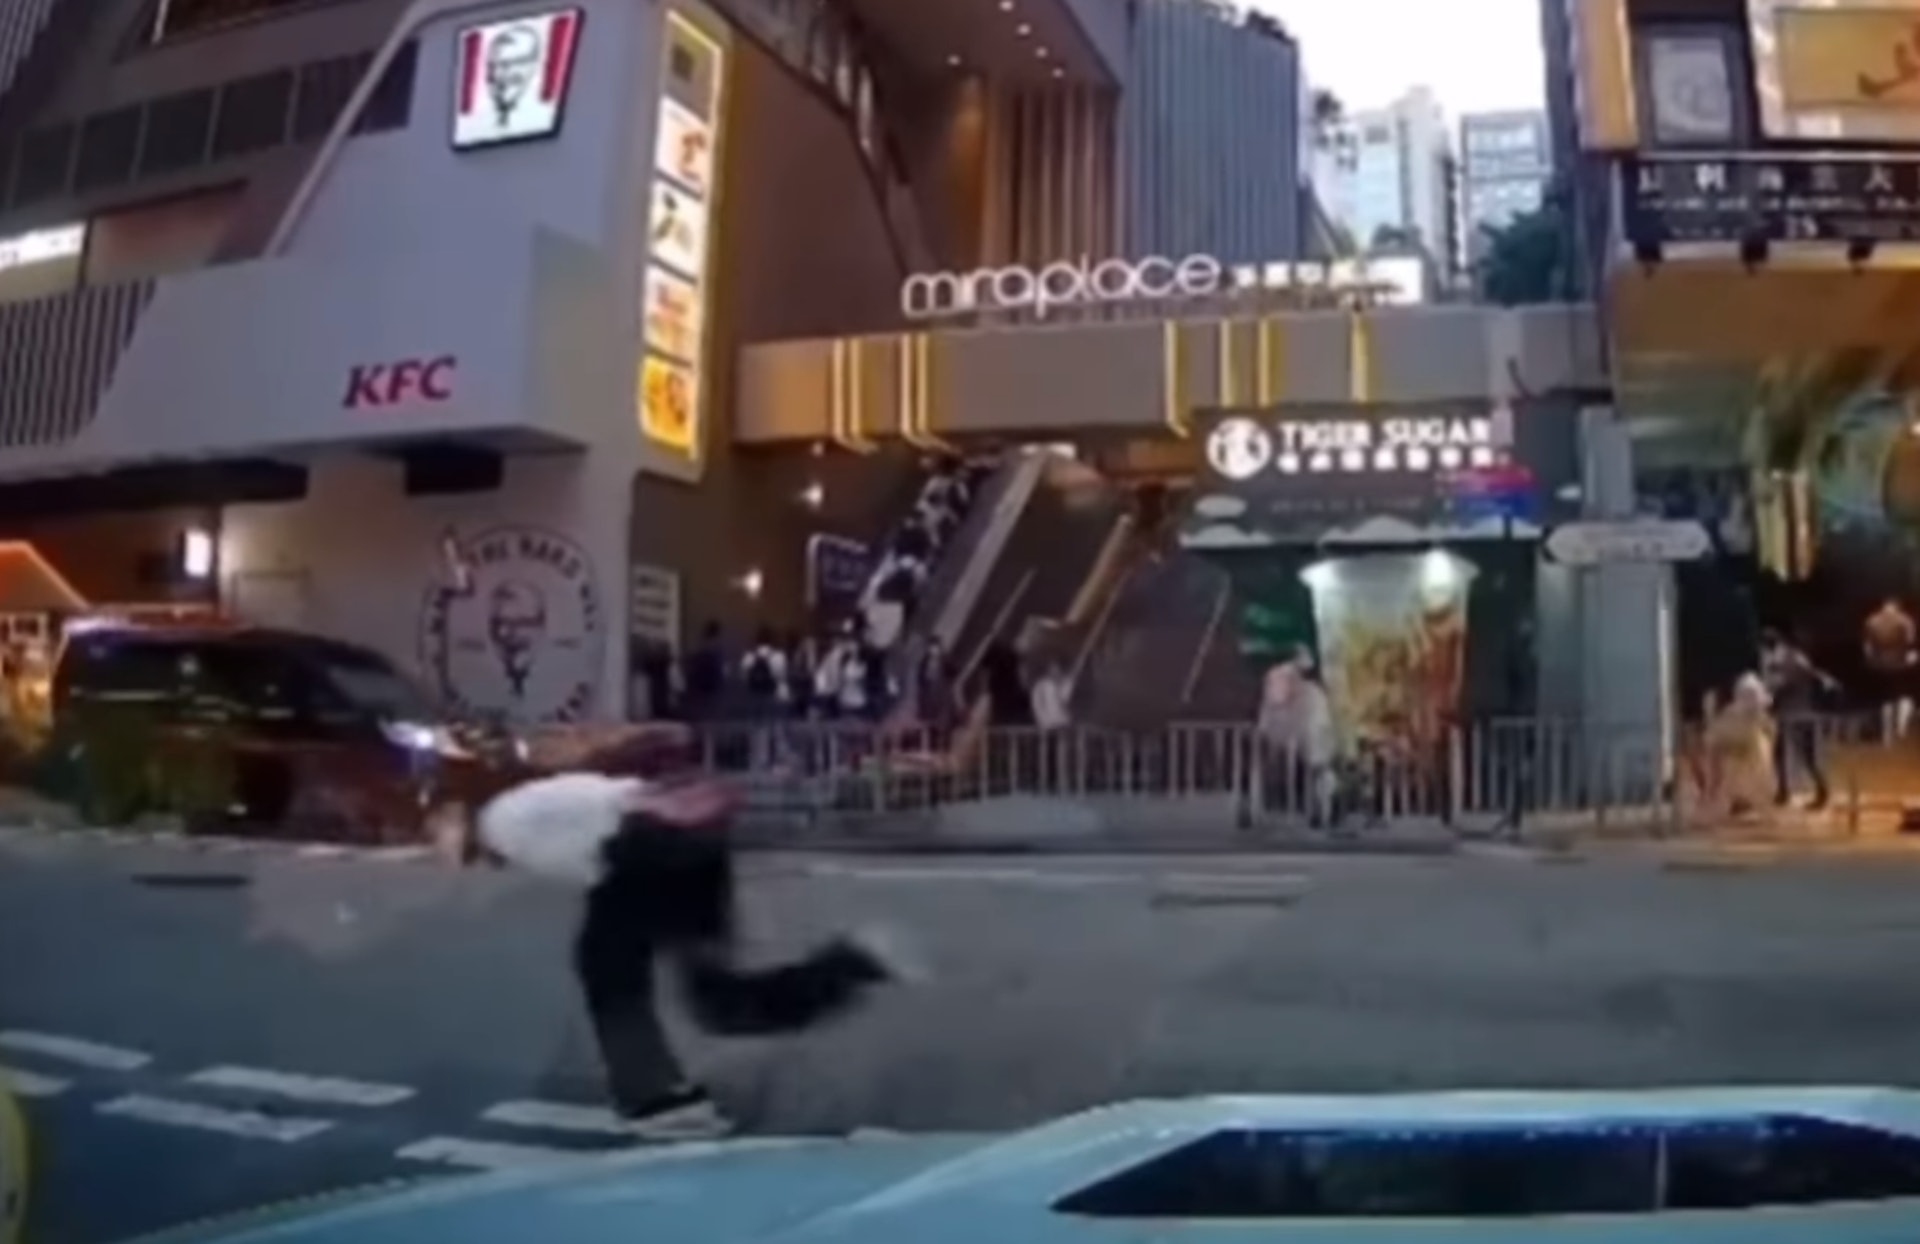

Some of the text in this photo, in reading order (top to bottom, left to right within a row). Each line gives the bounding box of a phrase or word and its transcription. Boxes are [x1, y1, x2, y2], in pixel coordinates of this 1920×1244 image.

[342, 354, 456, 408] KFC
[1279, 416, 1492, 449] TIGER SUGAR
